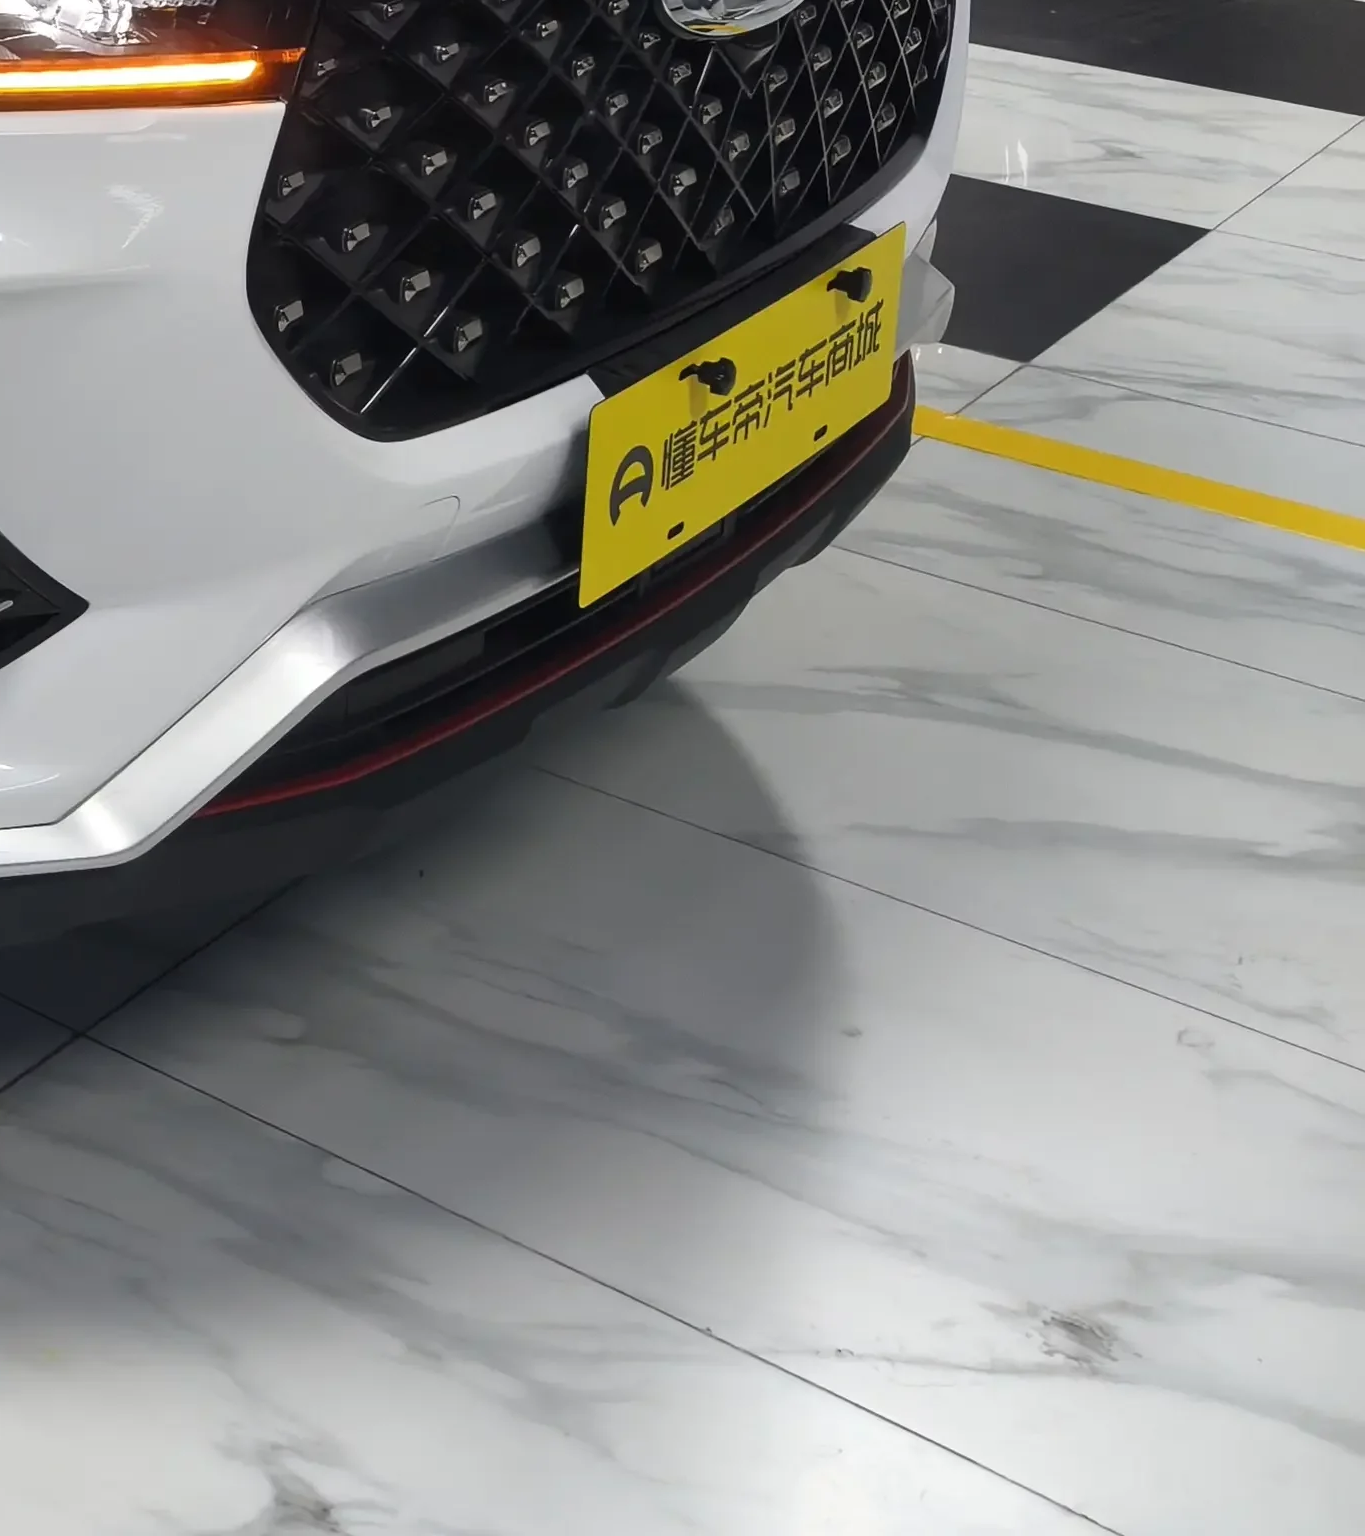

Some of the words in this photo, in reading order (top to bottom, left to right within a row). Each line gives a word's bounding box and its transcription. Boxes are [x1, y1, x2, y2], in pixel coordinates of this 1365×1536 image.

[661, 298, 884, 491] 懂车帝汽车商城
